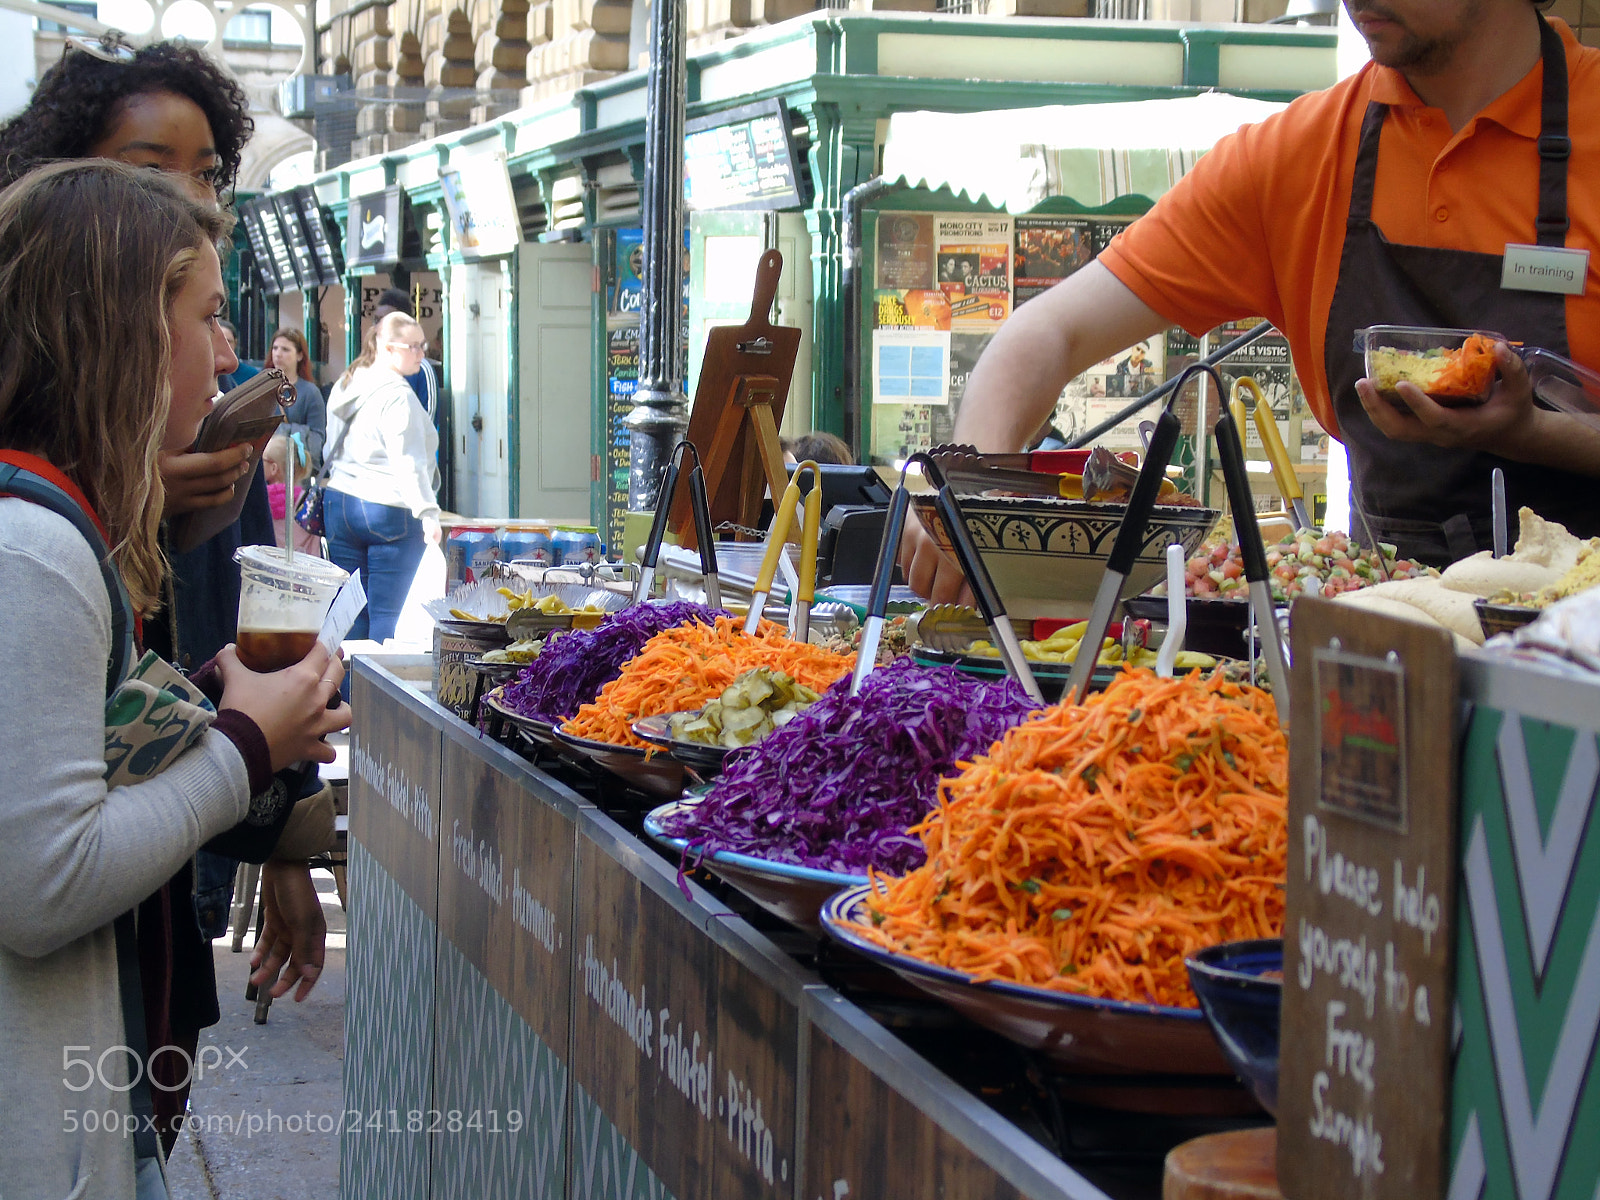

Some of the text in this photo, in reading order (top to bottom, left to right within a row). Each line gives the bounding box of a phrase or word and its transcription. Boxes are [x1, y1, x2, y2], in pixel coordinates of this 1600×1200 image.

[1000, 223, 1009, 232] 17
[879, 295, 897, 305] TAKE
[965, 275, 1007, 288] CACTUS
[1514, 263, 1574, 281] In training
[879, 314, 916, 325] SERIOUSLY
[479, 839, 503, 907] Salad
[1303, 814, 1440, 957] Please help
[1384, 940, 1410, 1014] to
[1414, 984, 1431, 1027] a
[1326, 1000, 1376, 1093] Free
[659, 1007, 713, 1122] Falafel
[728, 1069, 774, 1186] Pitta
[1310, 1070, 1385, 1178] Sample
